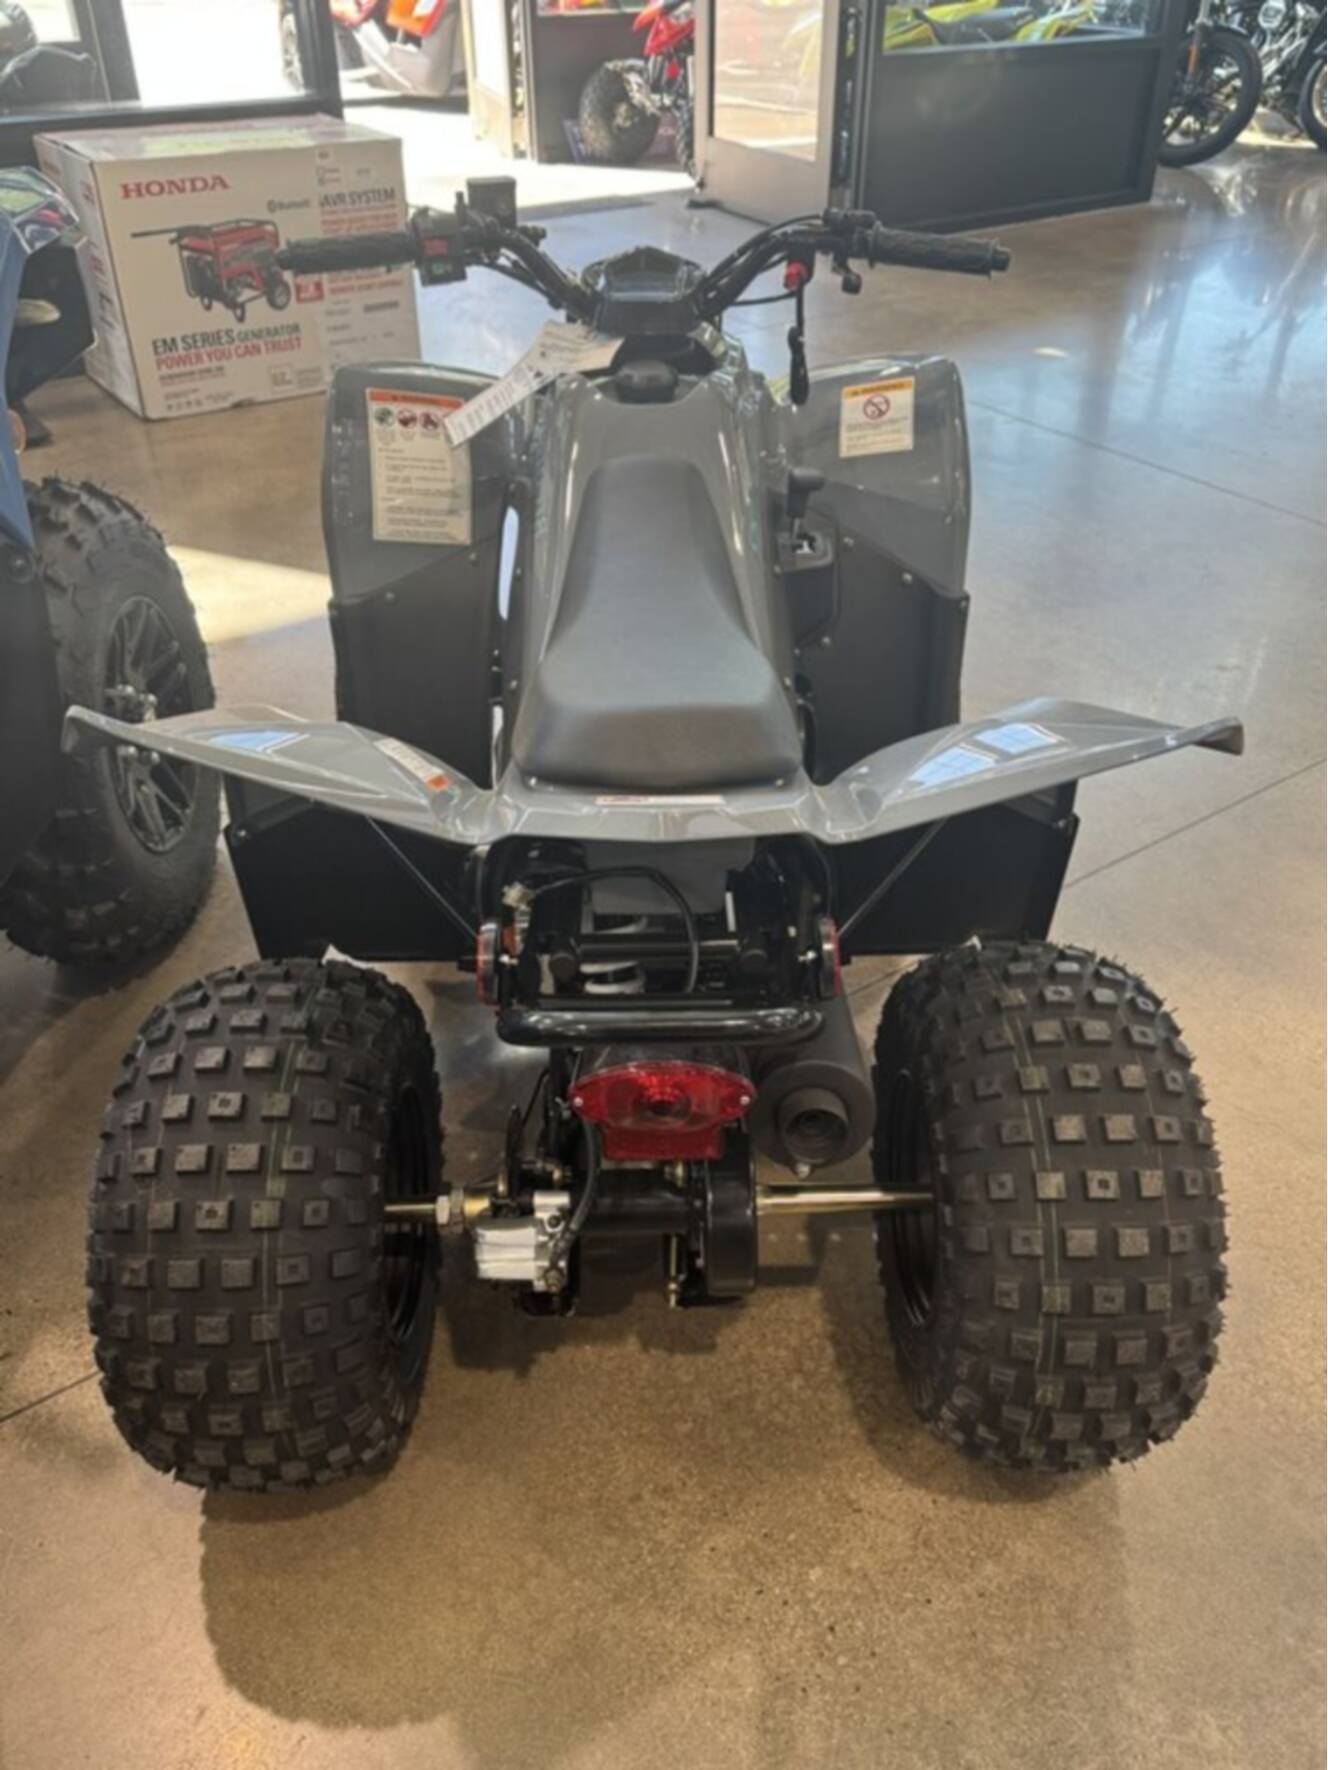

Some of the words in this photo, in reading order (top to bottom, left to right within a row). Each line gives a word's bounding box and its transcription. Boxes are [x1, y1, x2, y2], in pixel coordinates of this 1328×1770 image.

[120, 175, 230, 199] HONDA
[348, 187, 396, 205] SYSTEM
[152, 336, 178, 356] EM
[181, 328, 235, 351] SERIES
[236, 323, 300, 342] GENERATOR
[156, 350, 205, 371] POWER
[206, 347, 232, 362] YOU
[234, 343, 261, 359] CAN
[264, 336, 302, 353] TRUST
